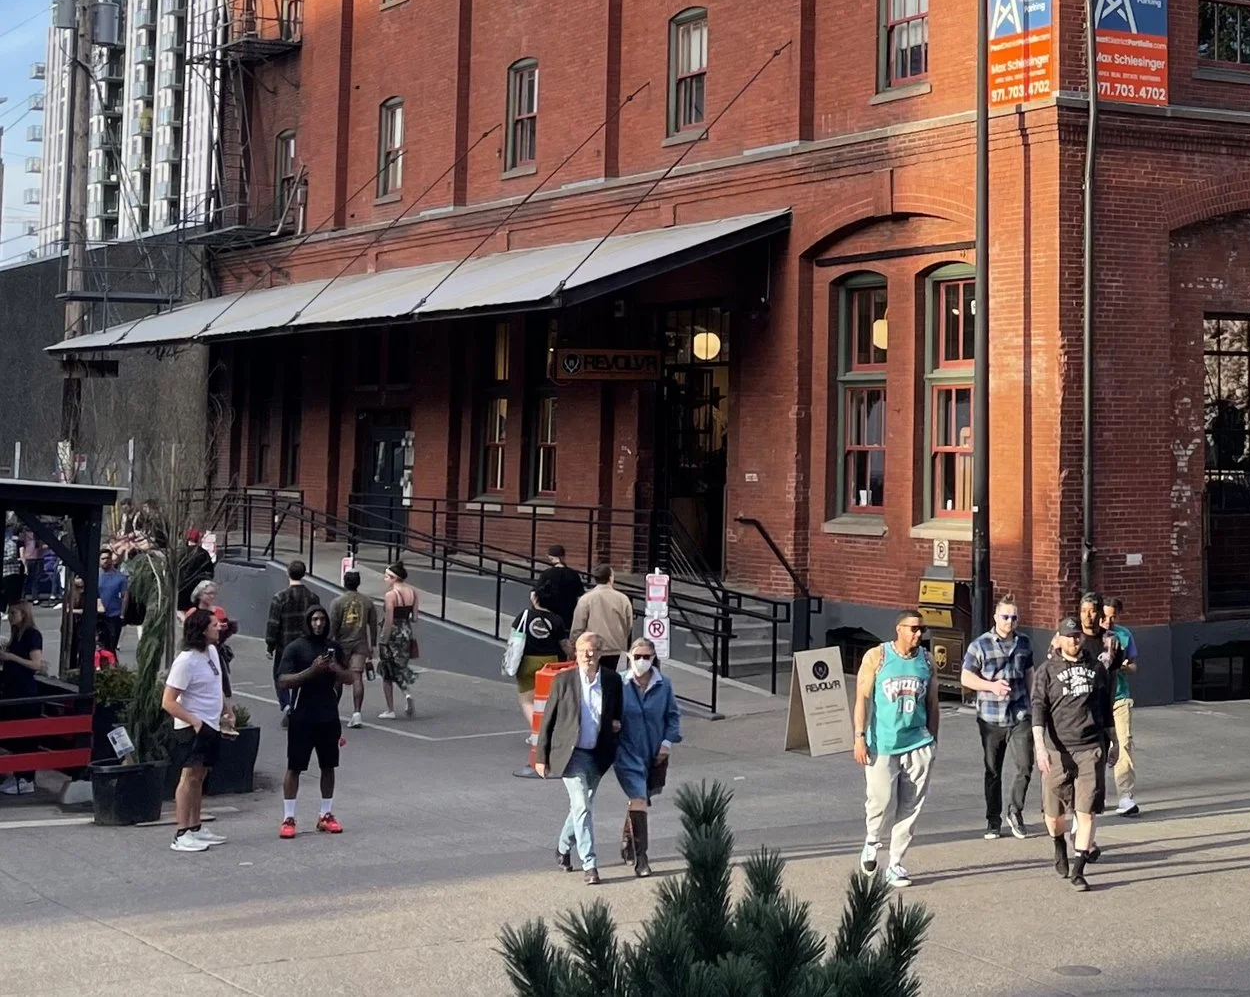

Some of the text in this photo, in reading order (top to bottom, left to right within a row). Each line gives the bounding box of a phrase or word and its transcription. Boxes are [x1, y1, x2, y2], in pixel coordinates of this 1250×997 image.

[1114, 53, 1166, 72] Schlesinger
[991, 79, 1050, 103] 971.703.4702
[583, 354, 658, 371] REVOLVR
[805, 680, 842, 693] REVOLVR
